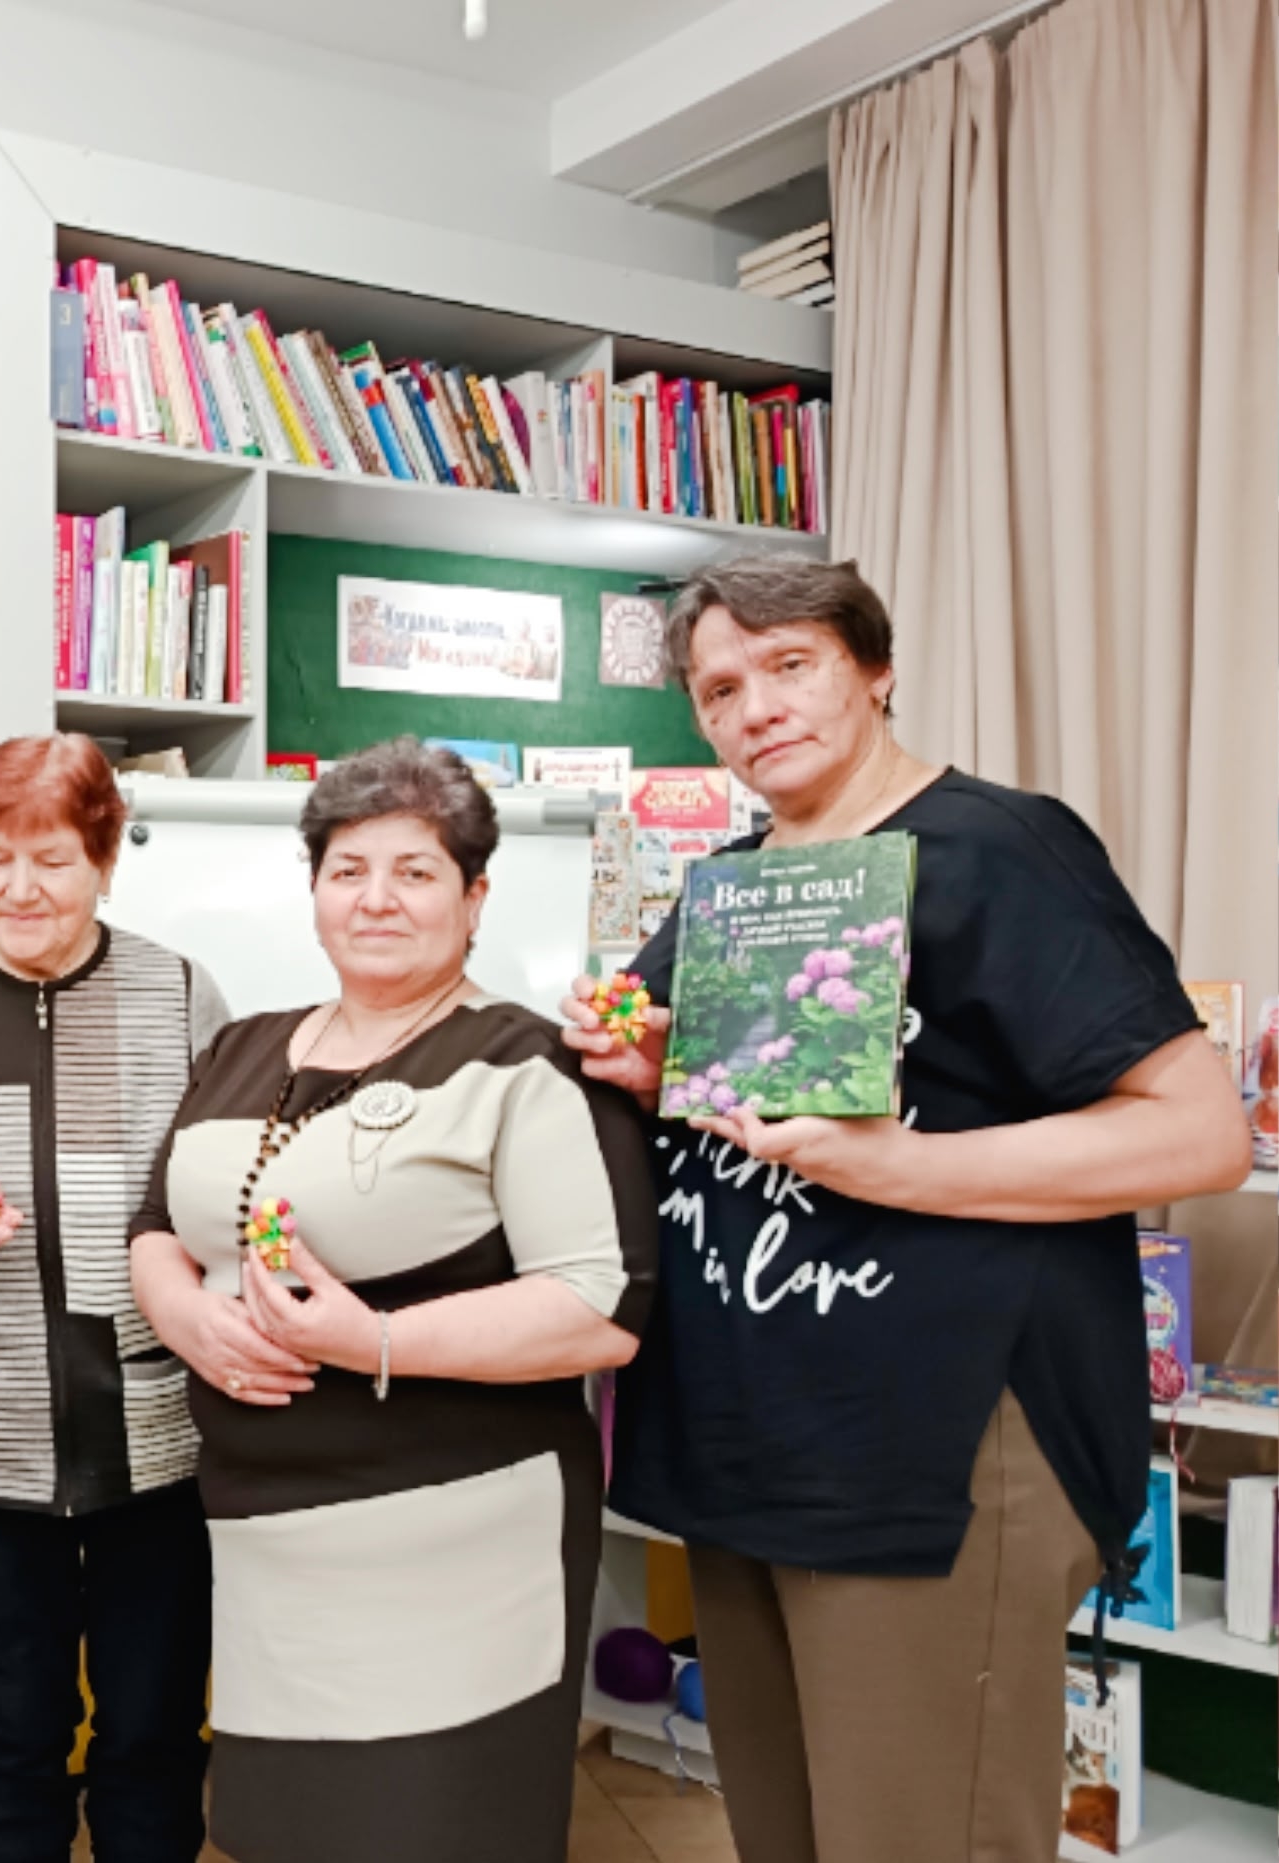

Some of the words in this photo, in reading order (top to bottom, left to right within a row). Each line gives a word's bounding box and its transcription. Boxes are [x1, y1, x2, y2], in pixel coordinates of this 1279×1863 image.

[714, 881, 768, 911] Все
[774, 882, 793, 905] в
[800, 867, 867, 902] сад!
[743, 1211, 894, 1316] love
